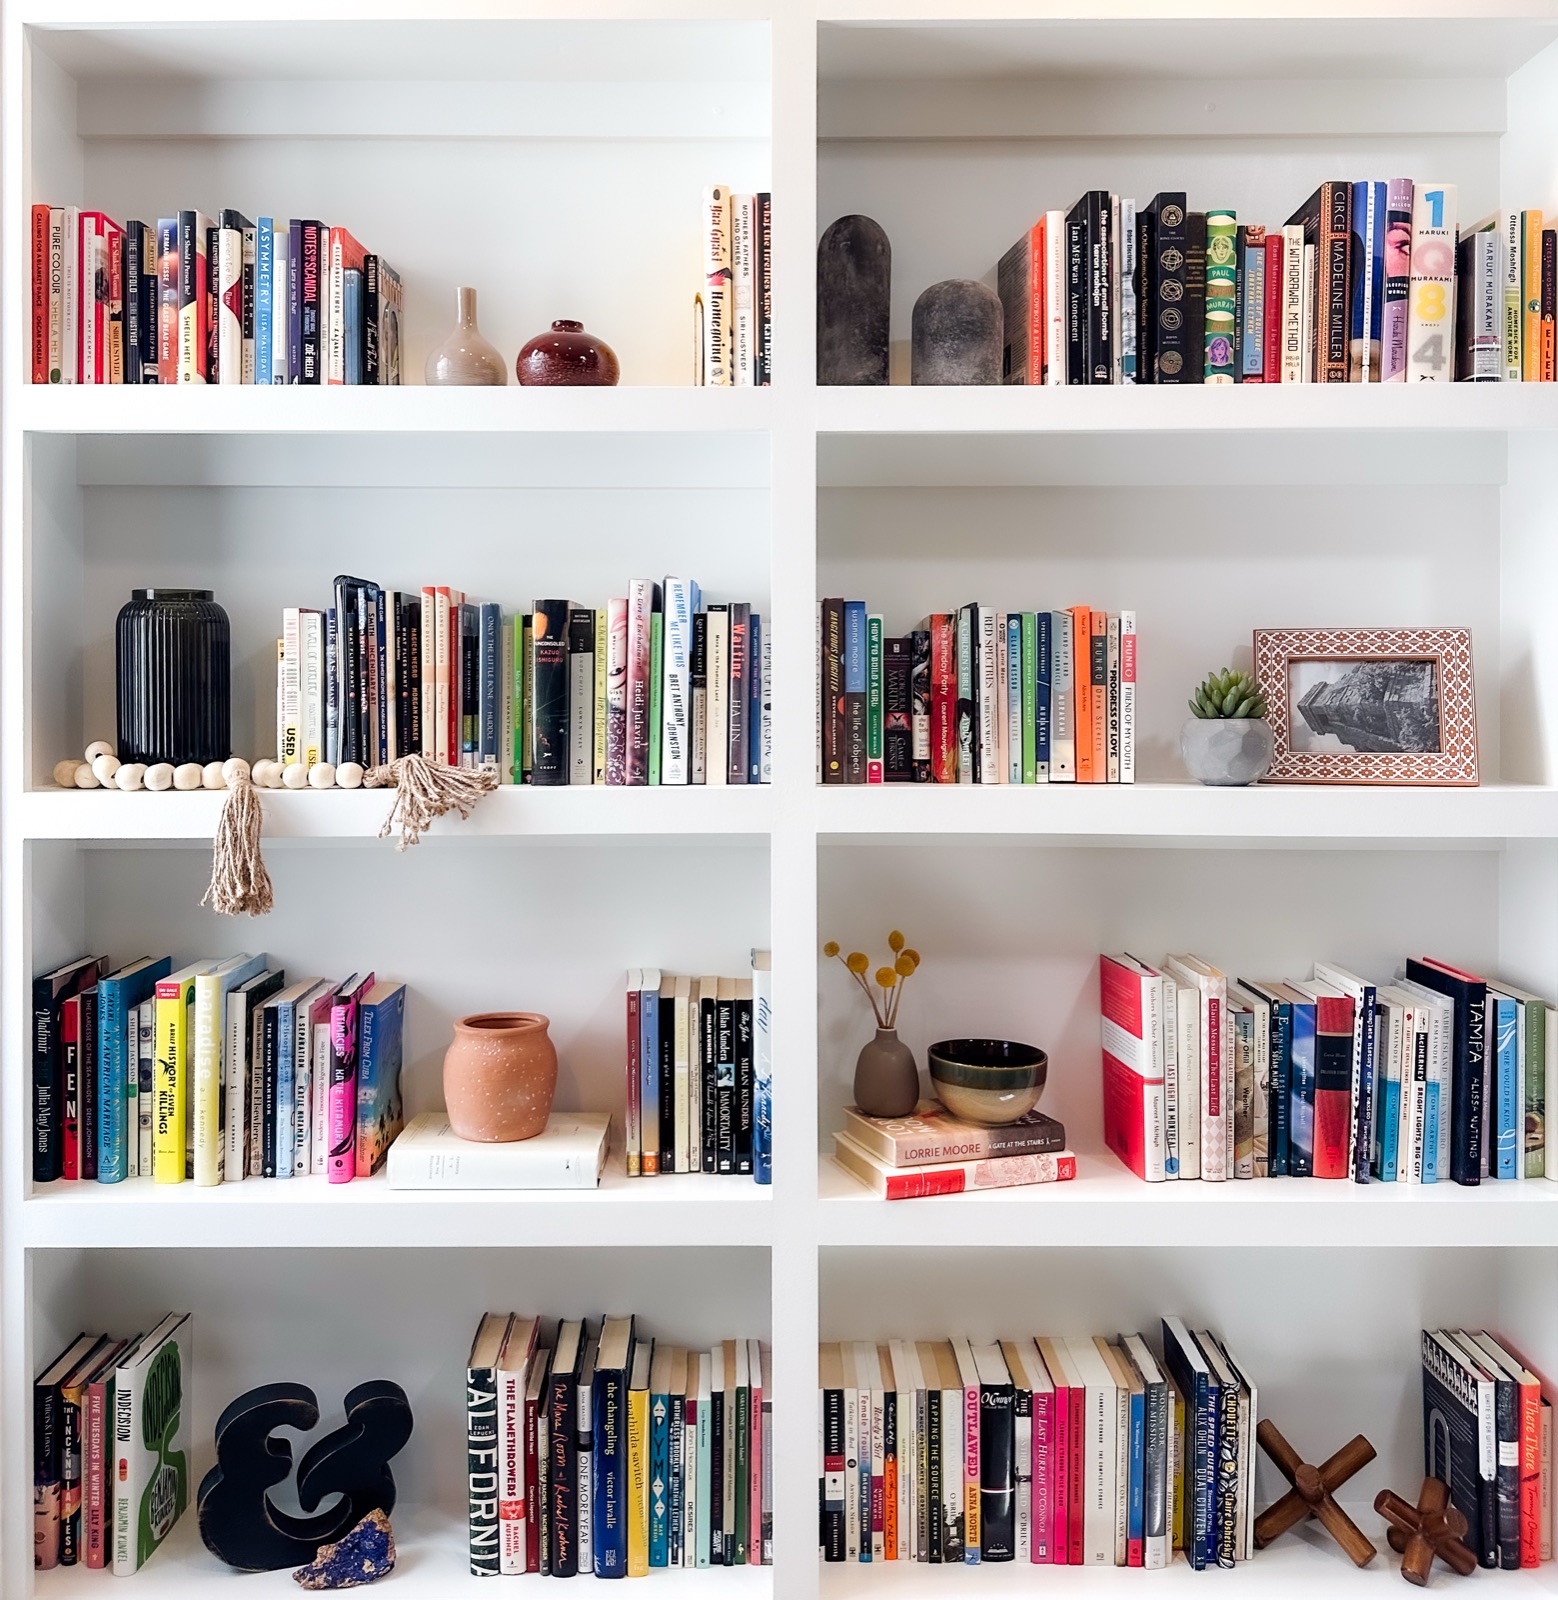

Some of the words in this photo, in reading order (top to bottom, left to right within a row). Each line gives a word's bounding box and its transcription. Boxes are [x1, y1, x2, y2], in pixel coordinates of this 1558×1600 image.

[1334, 192, 1345, 231] CIRCE
[1425, 191, 1444, 227] 1
[261, 226, 269, 304] ASYMMETRY
[1288, 248, 1300, 308] WITHDRAWAL
[1332, 241, 1344, 309] MADELINE
[1508, 246, 1516, 283] Moshfegh
[1101, 277, 1108, 286] of
[1071, 292, 1080, 342] Atonement
[1415, 284, 1446, 320] 8
[708, 291, 725, 363] Homegoing
[1288, 313, 1299, 351] METHOD
[1331, 314, 1342, 359] MILLER
[305, 344, 316, 355] ZOË
[1413, 334, 1446, 371] 4
[305, 356, 313, 378] HELLER
[673, 584, 687, 624] REMEMBER
[670, 621, 679, 631] ME
[672, 634, 682, 649] LIKE
[675, 652, 685, 668] THIS
[731, 624, 745, 679] Waiting
[939, 640, 948, 672] Birthday
[1125, 640, 1133, 677] MUNRO
[635, 680, 644, 706] Heidi
[669, 674, 679, 691] BRET
[940, 674, 948, 696] Party
[672, 694, 685, 727] ANTHONY
[853, 702, 861, 715] the
[853, 718, 861, 730] life
[632, 707, 644, 749] Julavits
[667, 722, 681, 760] JOHNSTON
[853, 733, 861, 741] of
[1110, 719, 1118, 731] OF
[286, 728, 295, 756] USED
[851, 743, 861, 774] objects
[37, 1008, 50, 1054] Vladimir
[335, 1007, 346, 1056] INTIMACIES
[720, 1007, 730, 1028] Milan
[1469, 1000, 1484, 1063] TAMPA
[104, 1029, 110, 1042] AN
[720, 1030, 729, 1061] Kundera
[37, 1085, 50, 1105] Julia
[1471, 1077, 1479, 1112] ALISSA
[1504, 1098, 1510, 1107] BE
[36, 1107, 50, 1126] May
[159, 1091, 168, 1134] KILLINGS
[720, 1091, 730, 1151] IMMORTALITY
[37, 1128, 50, 1153] Jonas
[905, 1146, 940, 1160] LORRIE
[942, 1144, 981, 1156] MOORE
[1026, 1138, 1044, 1147] STAIRS
[1470, 1116, 1478, 1158] NUTTING
[92, 1396, 100, 1413] FIVE
[506, 1379, 516, 1401] THE
[607, 1382, 616, 1399] the
[117, 1389, 132, 1442] INDECISION
[605, 1400, 617, 1455] changeling
[672, 1400, 681, 1440] MOTHERLESS
[1226, 1394, 1236, 1442] CHOUETTE
[1525, 1398, 1538, 1433] There
[92, 1417, 100, 1459] TUESDAYS
[967, 1390, 977, 1477] OUTLAWED
[506, 1403, 516, 1497] FLAMETHROWERS
[1525, 1435, 1538, 1470] There
[92, 1462, 100, 1471] IN
[467, 1368, 498, 1577] CALIFORNIA
[580, 1456, 588, 1480] ONE
[1197, 1468, 1206, 1492] DUAL
[91, 1474, 100, 1506] WINTER
[580, 1483, 589, 1514] MORE
[606, 1472, 616, 1498] victor
[91, 1509, 100, 1525] LILY
[118, 1498, 128, 1533] BENJAMIN
[580, 1517, 589, 1544] YEAR
[607, 1501, 616, 1529] lavalle
[1197, 1497, 1206, 1541] CITIZENS
[91, 1529, 99, 1549] KING
[118, 1535, 128, 1563] KUNKEL
